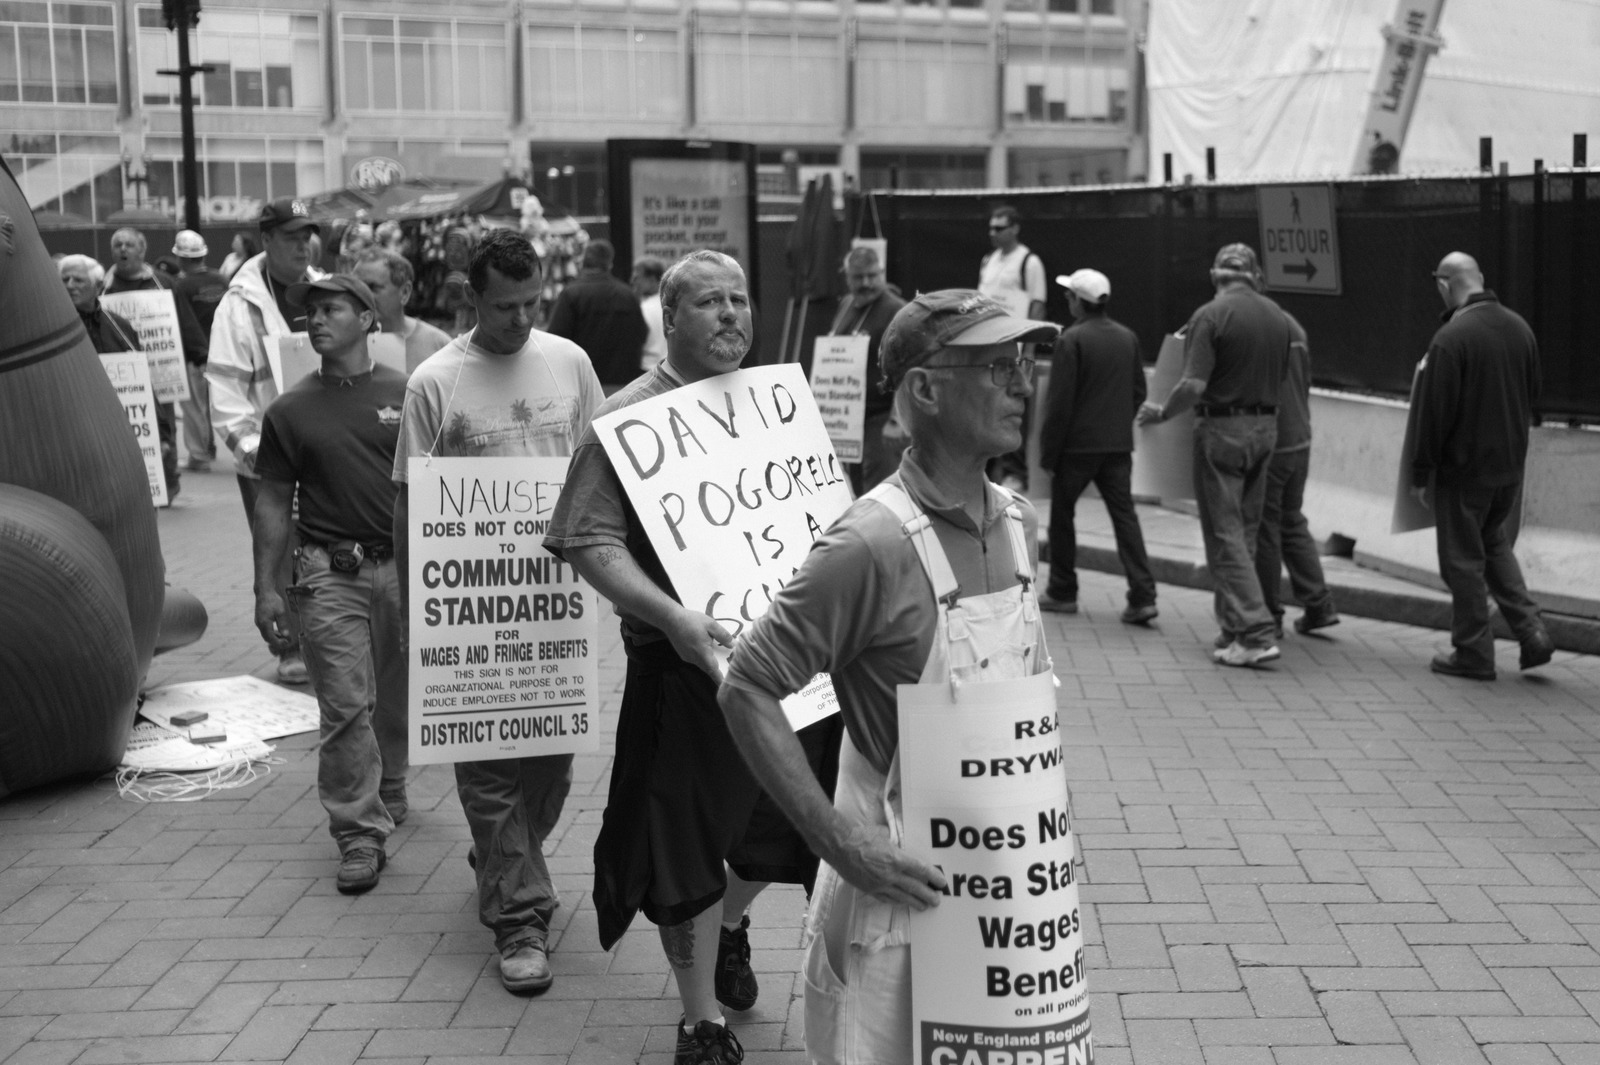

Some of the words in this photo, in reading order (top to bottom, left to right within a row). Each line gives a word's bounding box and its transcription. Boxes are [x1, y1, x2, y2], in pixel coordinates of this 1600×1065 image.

[1266, 228, 1331, 254] DETOUR
[614, 383, 797, 481] DAVID
[422, 522, 466, 538] DOES
[475, 521, 506, 536] NOT
[743, 524, 785, 566] IS
[805, 512, 823, 542] A
[499, 543, 516, 554] TO
[424, 591, 584, 627] STANDARDS
[495, 630, 519, 641] FOR
[420, 646, 460, 667] WAGES
[465, 644, 489, 665] AND
[494, 642, 533, 663] FRINGE
[538, 638, 588, 661] BENEFITS
[425, 682, 505, 694] ORGANIZATIONAL
[509, 678, 551, 689] PURPOSE
[555, 676, 568, 686] OR
[572, 675, 584, 685] TO
[454, 670, 474, 680] THIS
[479, 668, 500, 678] SIGN
[505, 668, 514, 676] IS
[518, 666, 536, 676] NOT
[541, 664, 559, 674] FOR
[423, 697, 457, 708] INDUCE
[462, 694, 516, 706] EMPLOYEES
[520, 692, 539, 702] NOT
[544, 691, 555, 699] TO
[560, 688, 586, 699] WORK
[817, 702, 826, 711] OF
[821, 690, 836, 700] ONL
[421, 720, 495, 747] DISTRICT
[499, 714, 567, 741] COUNCIL
[571, 713, 588, 734] 35
[930, 818, 1026, 851] Does
[978, 907, 1080, 952] Wages
[986, 947, 1087, 998] Benefi
[1015, 1007, 1032, 1017] on
[1037, 1002, 1053, 1015] all
[933, 1028, 968, 1045] New
[973, 1031, 1040, 1049] England
[1045, 1017, 1091, 1045] Regiona
